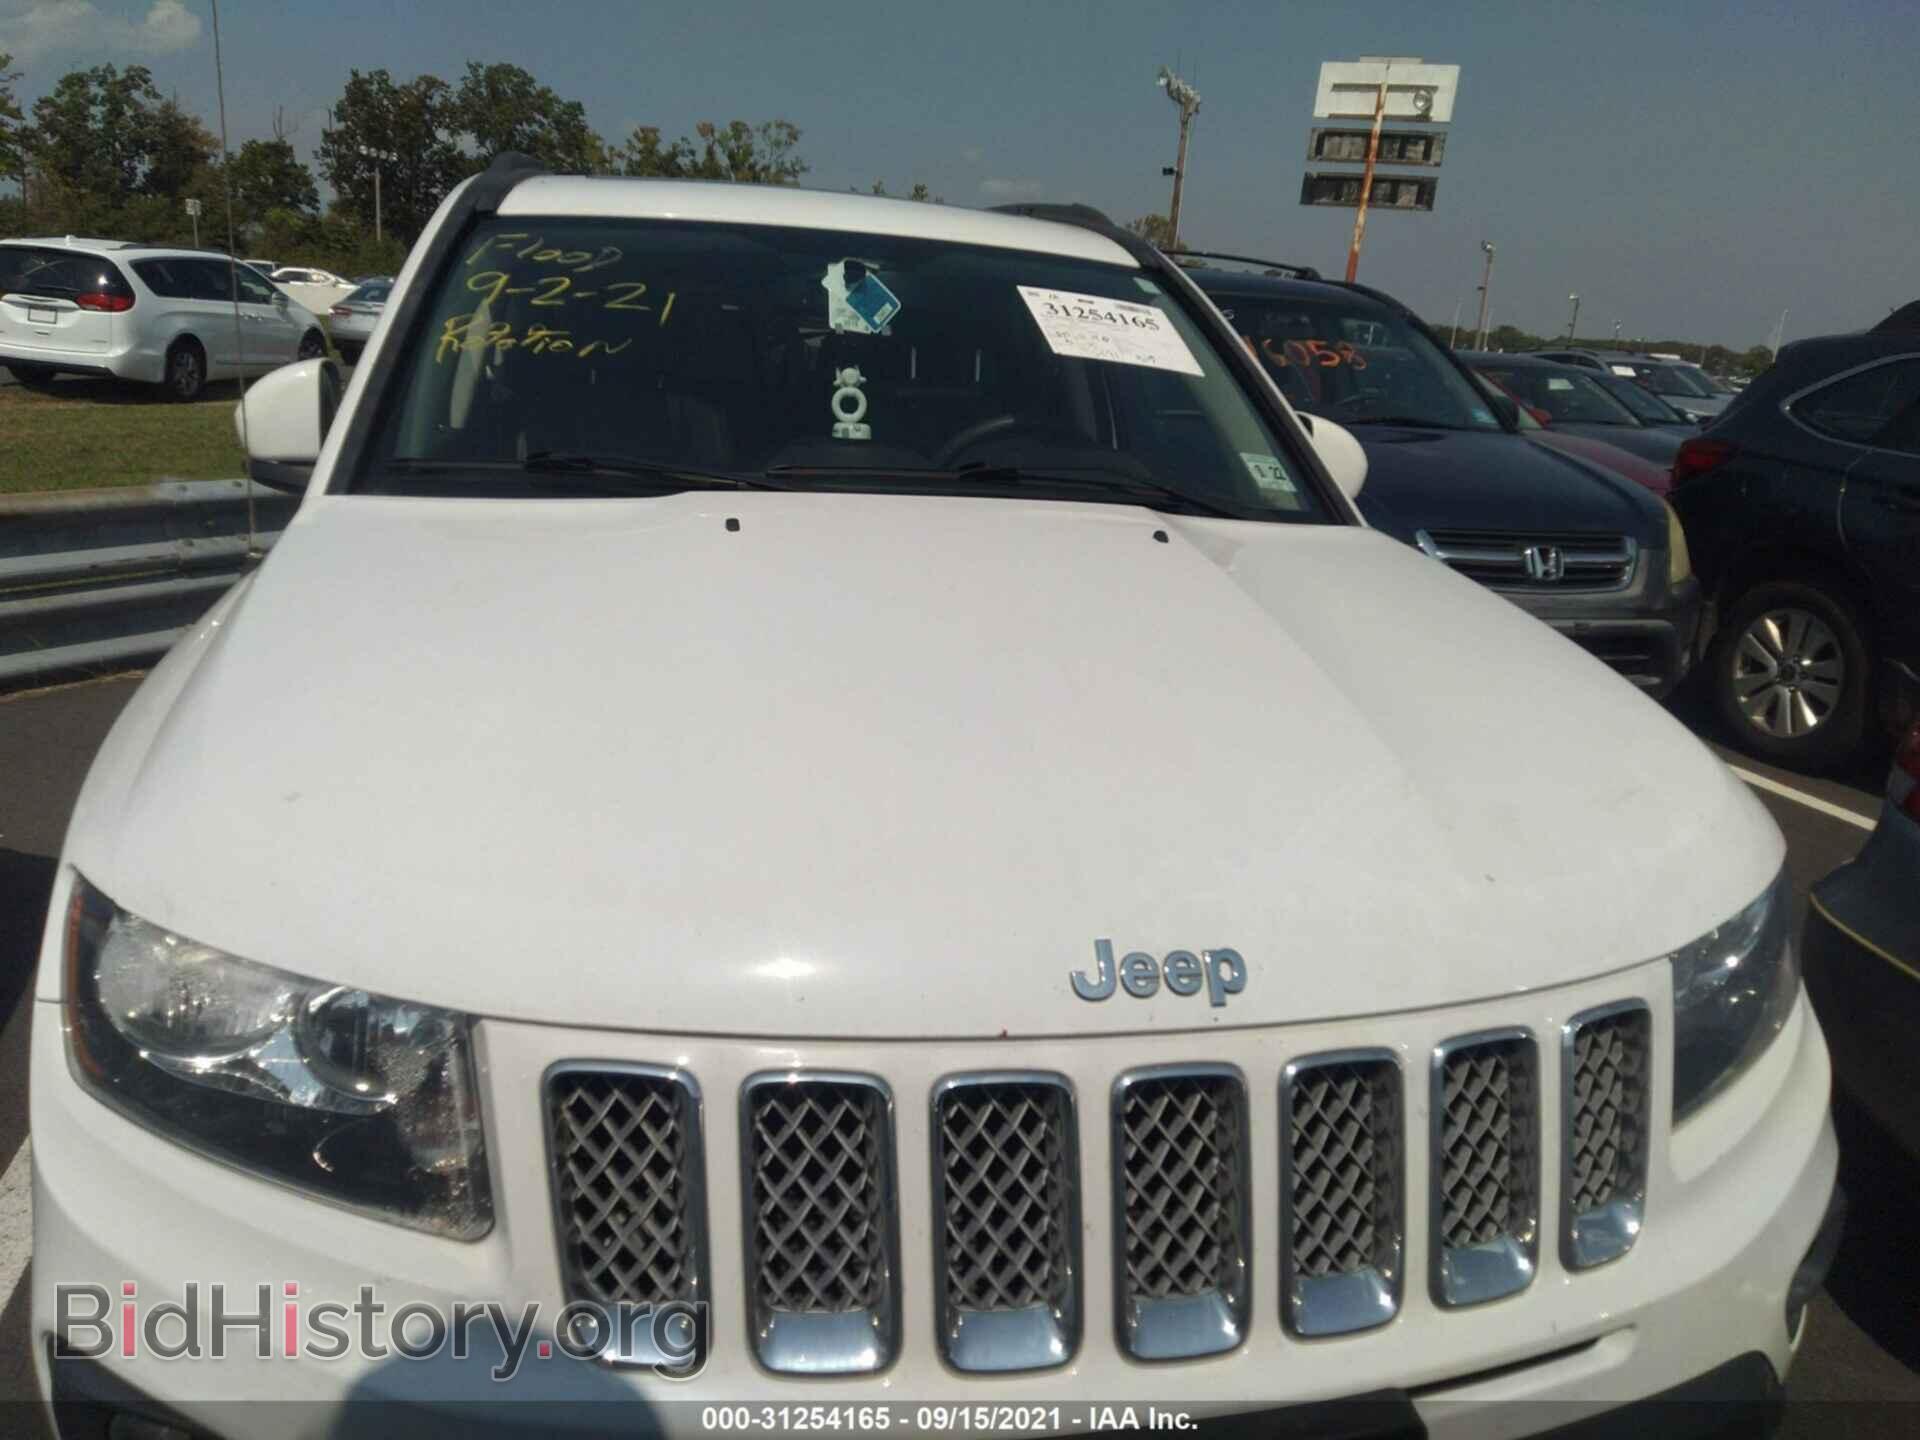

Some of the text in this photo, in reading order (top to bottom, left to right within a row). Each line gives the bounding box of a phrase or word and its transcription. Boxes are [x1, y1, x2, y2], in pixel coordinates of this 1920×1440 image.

[466, 271, 676, 327] 9-2-21
[1041, 302, 1160, 332] 31254165
[1069, 938, 1248, 1008] Jeep
